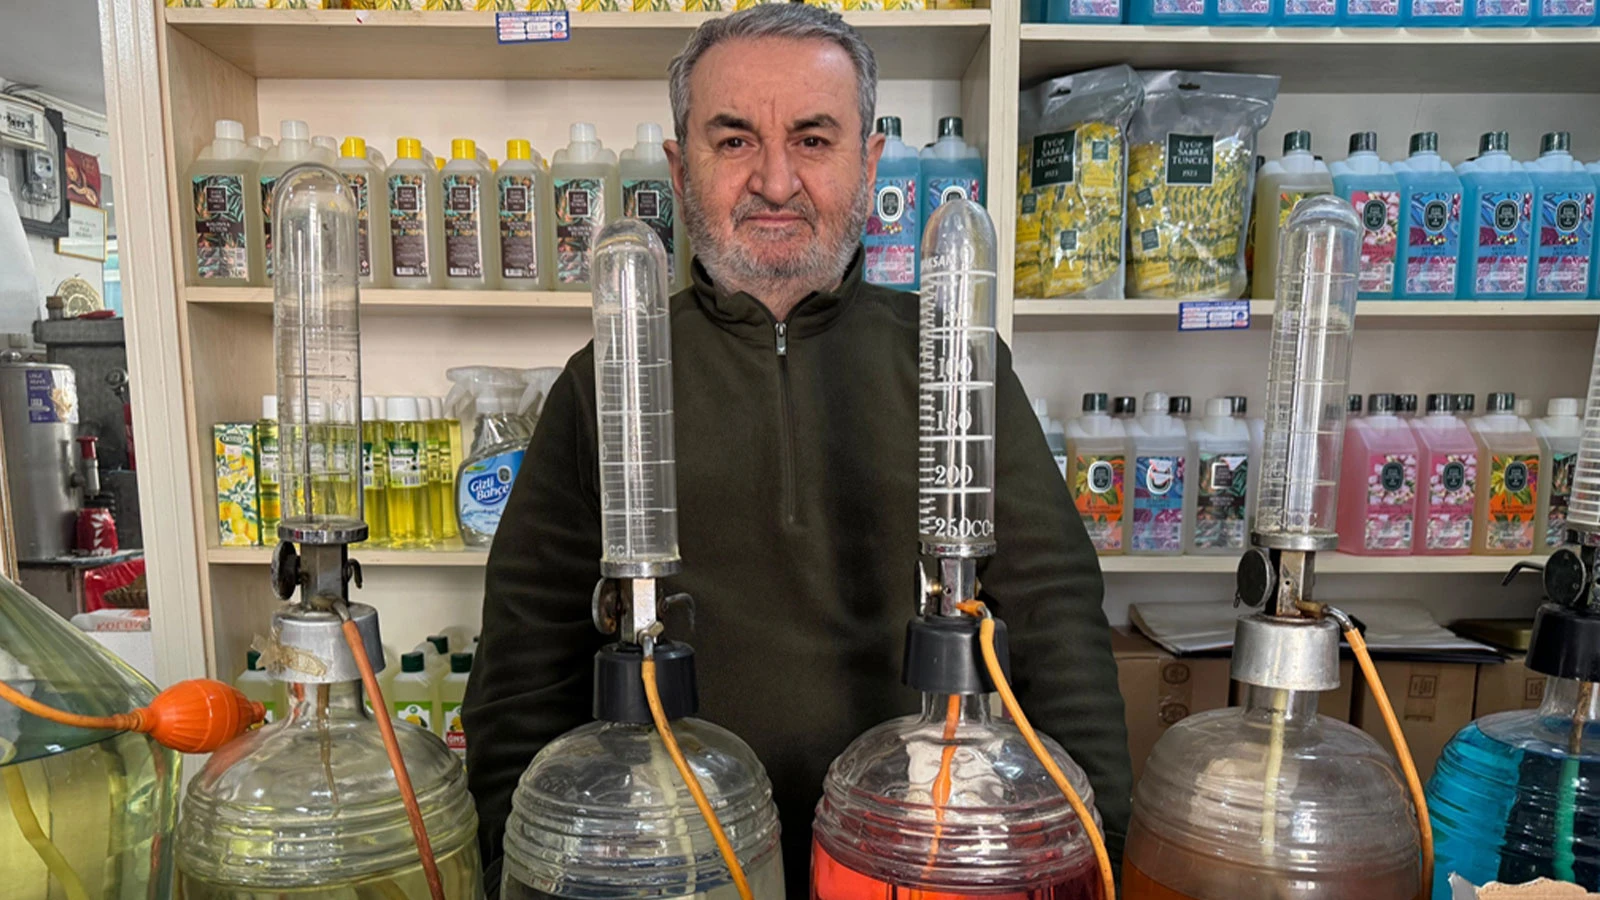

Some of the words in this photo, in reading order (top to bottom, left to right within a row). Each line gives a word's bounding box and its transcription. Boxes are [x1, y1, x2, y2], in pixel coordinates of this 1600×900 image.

[1171, 156, 1209, 165] TUNCER
[938, 356, 973, 379] 100
[936, 409, 973, 432] 150
[471, 475, 495, 493] Gizli
[934, 464, 973, 485] 200
[476, 485, 509, 501] Bahçe
